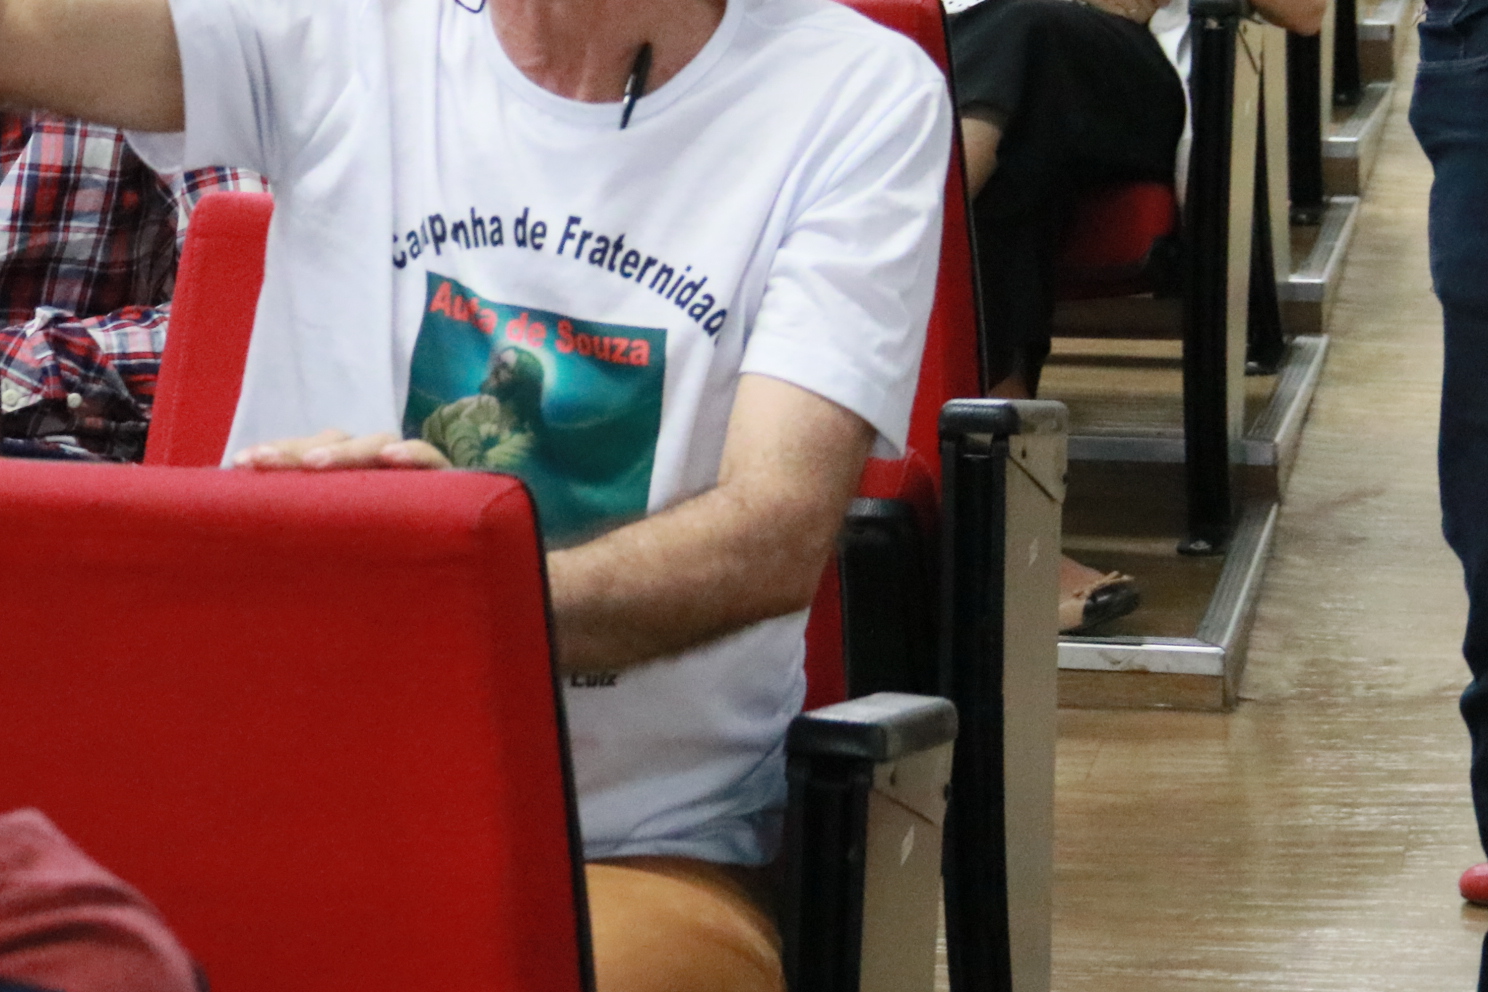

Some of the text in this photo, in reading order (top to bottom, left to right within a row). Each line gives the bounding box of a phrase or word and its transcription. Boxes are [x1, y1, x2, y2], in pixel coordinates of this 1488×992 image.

[513, 206, 548, 251] de
[505, 312, 548, 348] de
[554, 319, 652, 368] Souza
